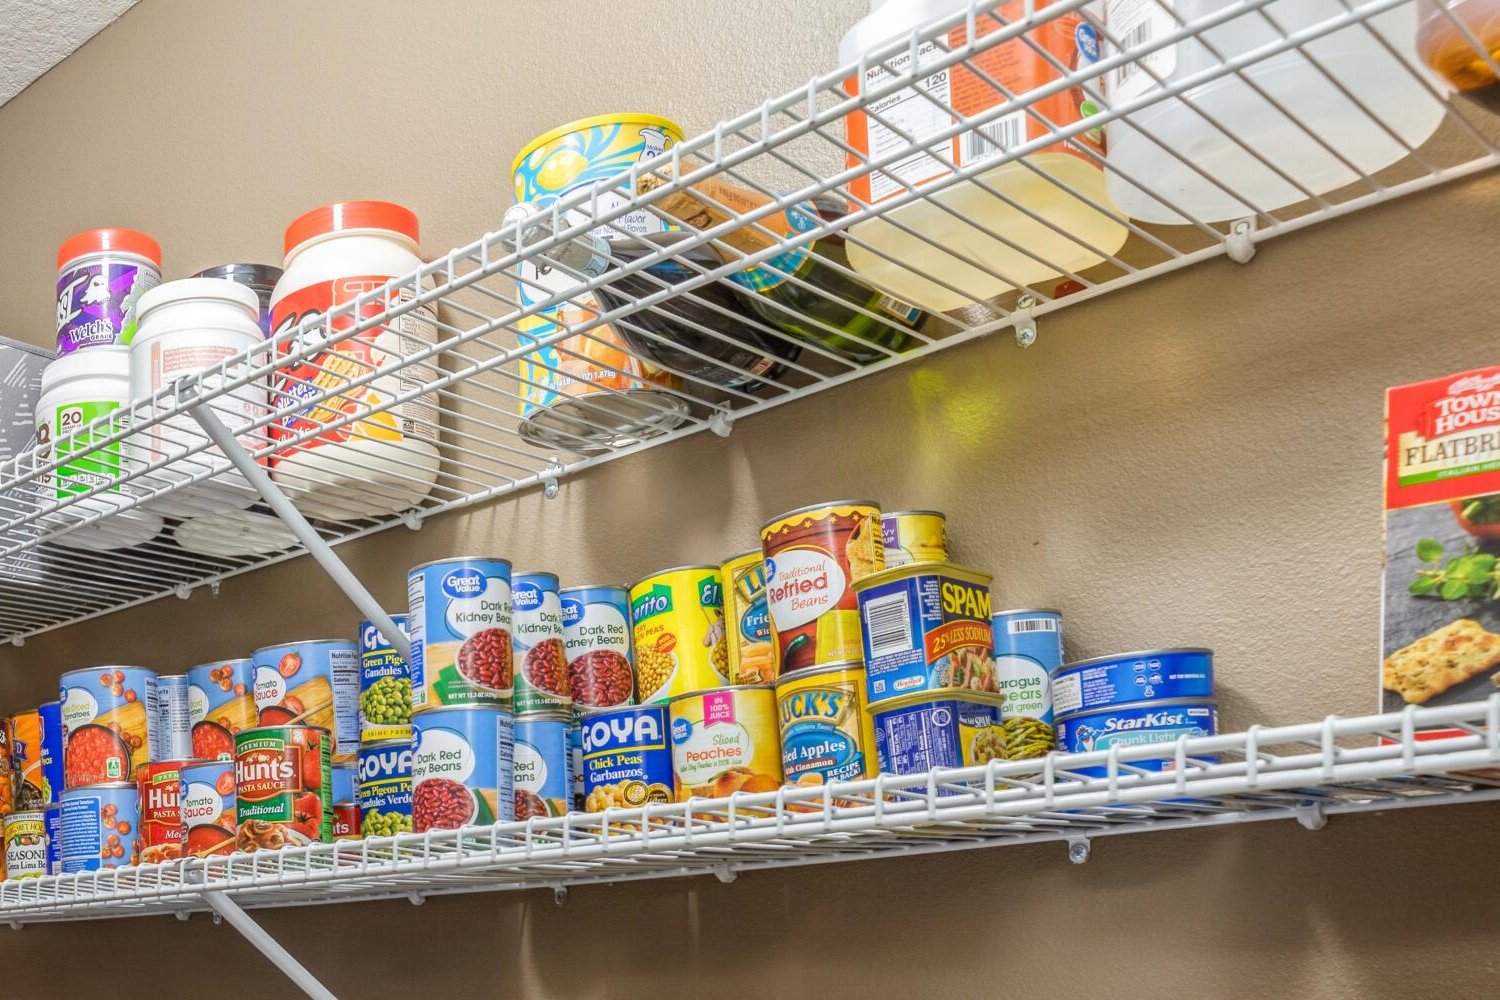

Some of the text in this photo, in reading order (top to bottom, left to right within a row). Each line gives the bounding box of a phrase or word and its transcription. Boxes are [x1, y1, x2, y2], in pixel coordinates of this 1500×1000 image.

[926, 73, 946, 87] 120
[69, 318, 114, 343] Welch's
[62, 411, 82, 426] 20
[1405, 432, 1500, 466] FLATBR
[778, 560, 826, 581] Traditional
[446, 574, 480, 588] Great
[456, 584, 480, 592] Value
[770, 572, 828, 603] Refried
[481, 601, 502, 611] Dark
[791, 594, 829, 611] Beans
[942, 582, 992, 620] SPAM
[456, 612, 494, 624] Kidney
[518, 623, 551, 636] Kidney
[580, 624, 624, 636] Dark Red
[950, 629, 964, 643] LESS
[597, 634, 624, 646] Beans
[363, 656, 383, 668] Green
[364, 666, 402, 679] Gandules
[709, 703, 729, 712] 100%
[714, 697, 723, 705] IN
[1016, 701, 1043, 713] green
[708, 710, 731, 719] JUICE
[1104, 714, 1188, 731] StarKist
[240, 740, 276, 751] PREMIUM
[712, 733, 741, 745] Sliced
[1108, 731, 1177, 746] Chunk Light
[686, 747, 742, 763] Peaches
[800, 740, 847, 759] Apples
[418, 750, 462, 764] Dark Red
[589, 754, 643, 770] Chick Peas
[429, 762, 462, 774] Beans
[795, 758, 834, 772] Cinnamon
[827, 760, 861, 777] RECIPE
[590, 766, 644, 784] Garbanzos
[839, 766, 862, 781] BACK!
[238, 781, 286, 794] PASTA SAUCE
[372, 784, 400, 798] Pigeon
[184, 797, 213, 807] Tomato
[154, 811, 175, 819] PASTA
[184, 805, 214, 817] Sauce
[239, 803, 284, 818] Traditional
[21, 859, 37, 869] Lima
